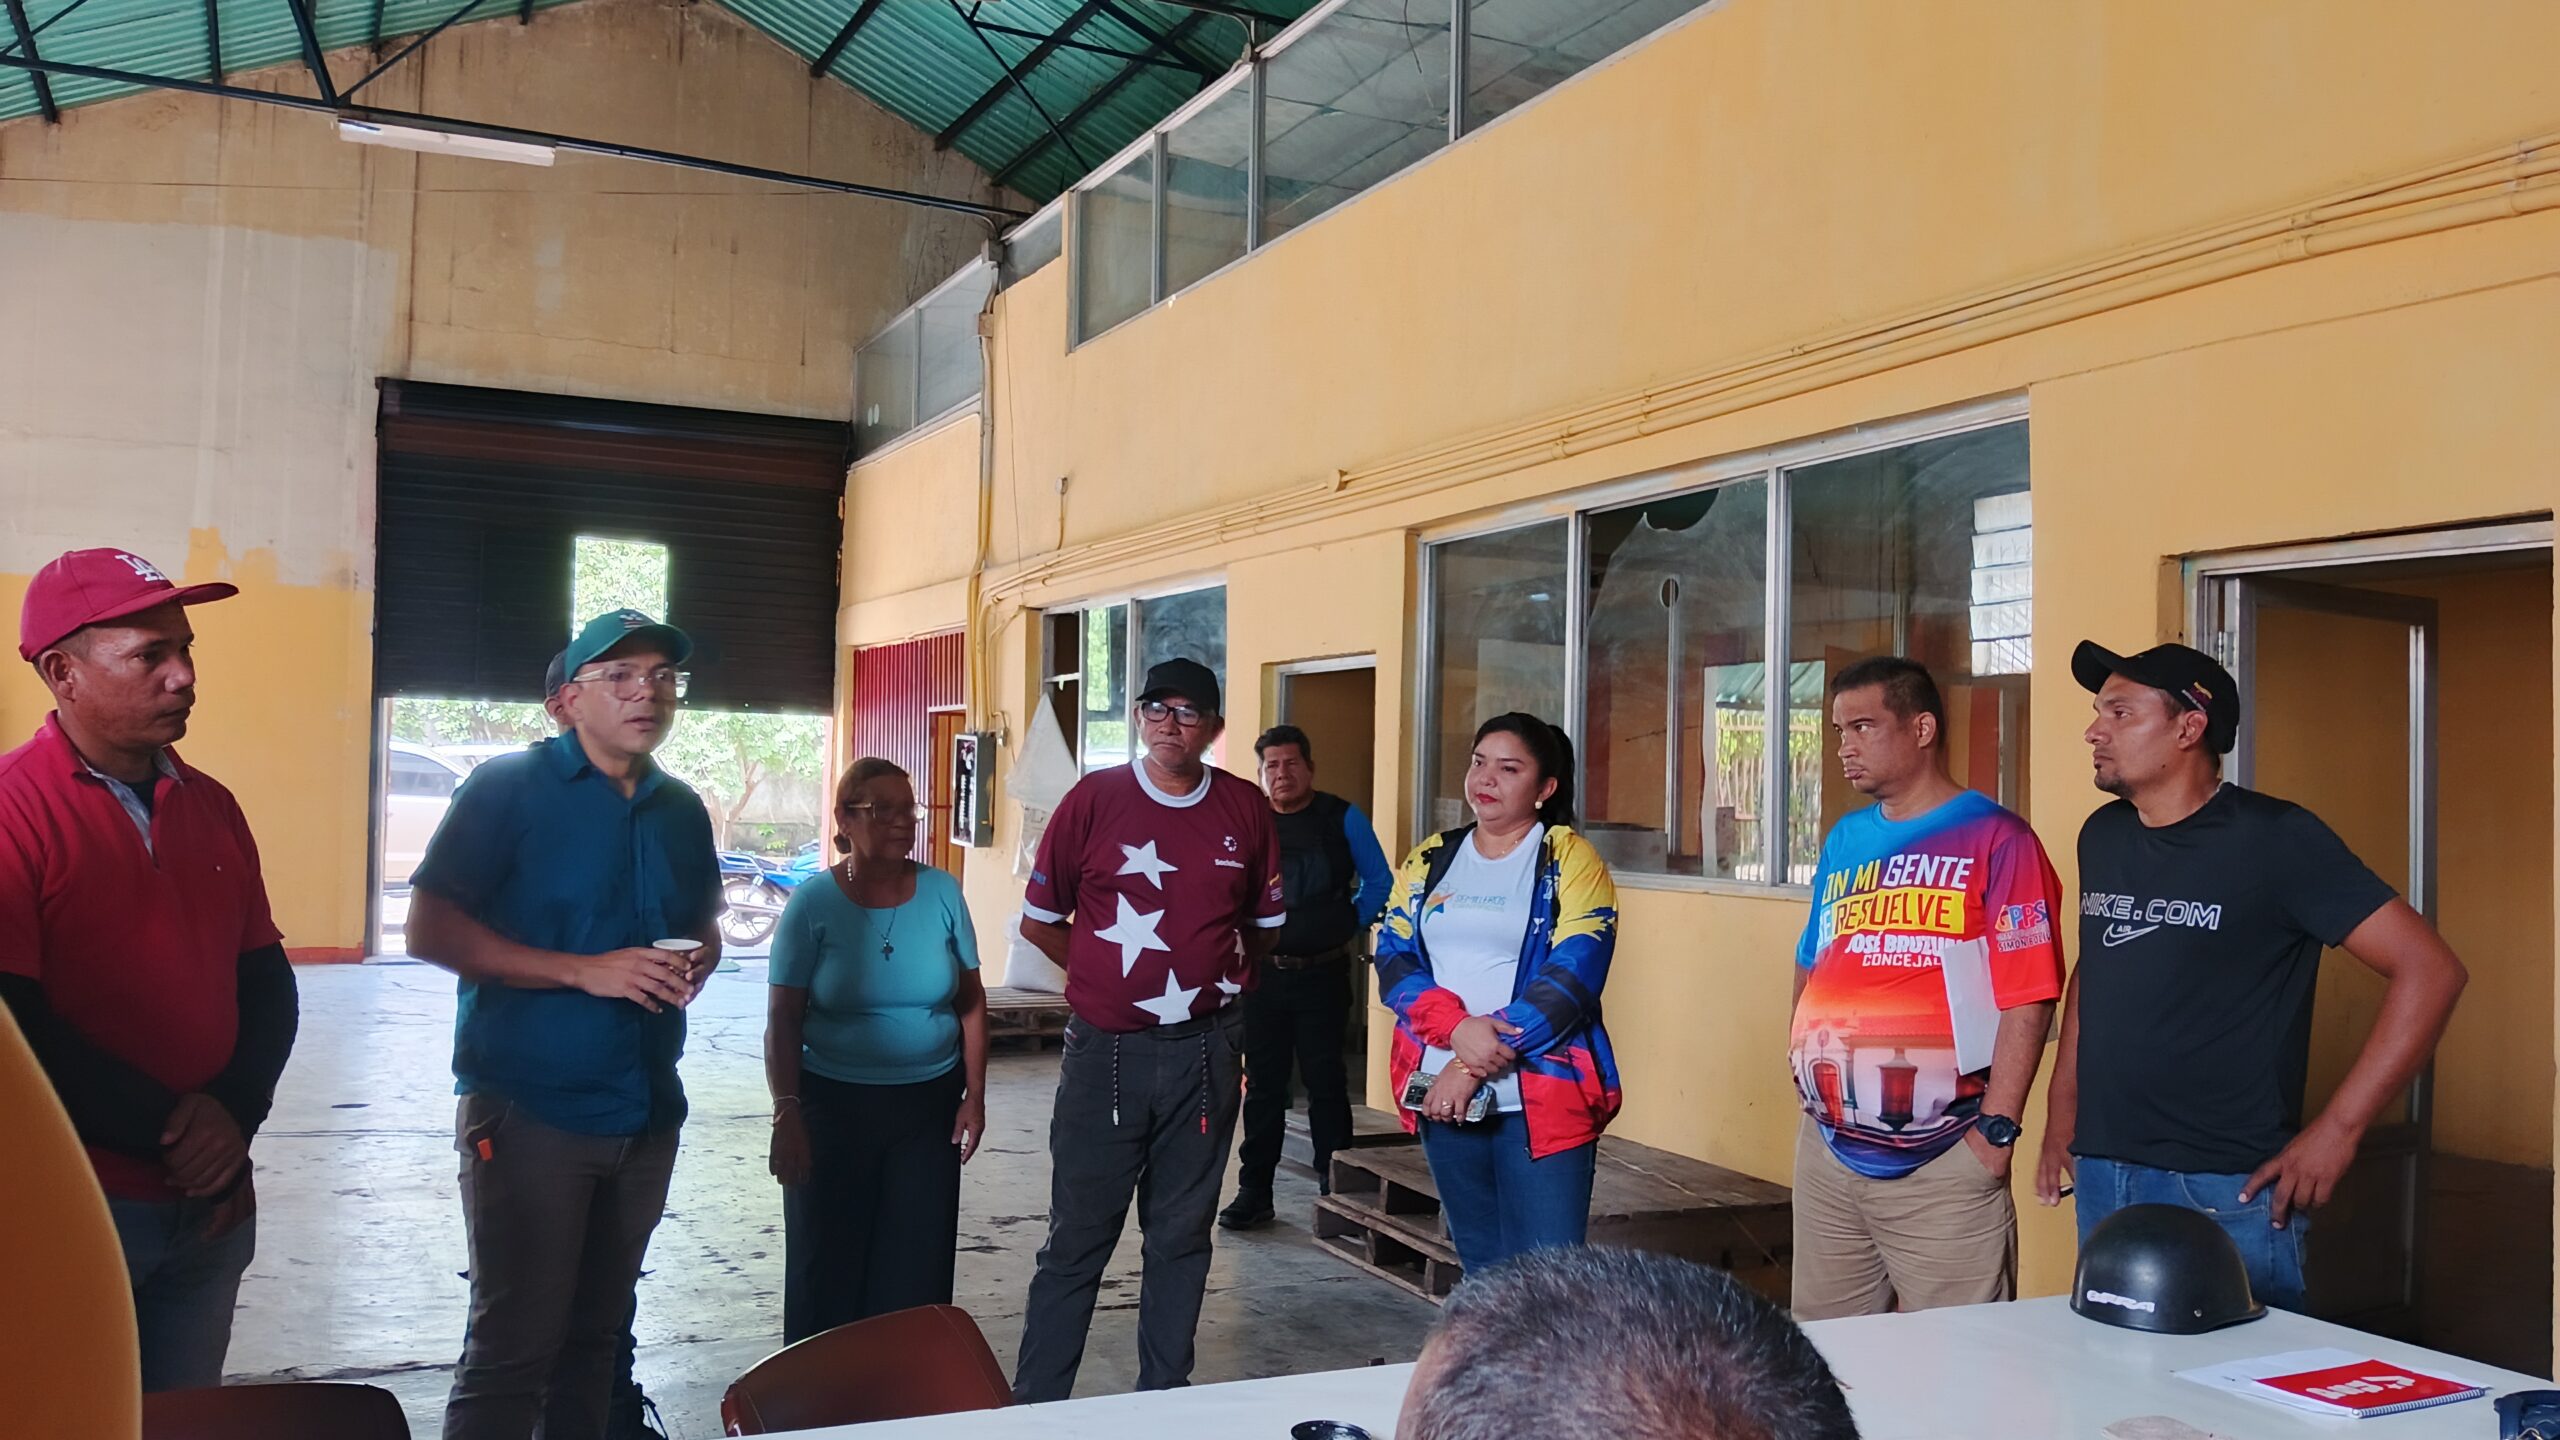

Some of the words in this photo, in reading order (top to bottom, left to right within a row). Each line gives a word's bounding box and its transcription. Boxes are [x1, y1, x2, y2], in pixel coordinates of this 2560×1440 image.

[1821, 867, 1850, 905] ON
[1851, 859, 1881, 894] MI
[1882, 854, 1974, 889] GENTE
[1834, 892, 1953, 935] RESUELVE
[2080, 892, 2221, 930] NIKE.COM
[1844, 930, 1883, 954] JOSÉ
[1884, 933, 1963, 957] BRUZU
[2117, 925, 2132, 933] AIR
[1861, 953, 1943, 968] CONCEJAL
